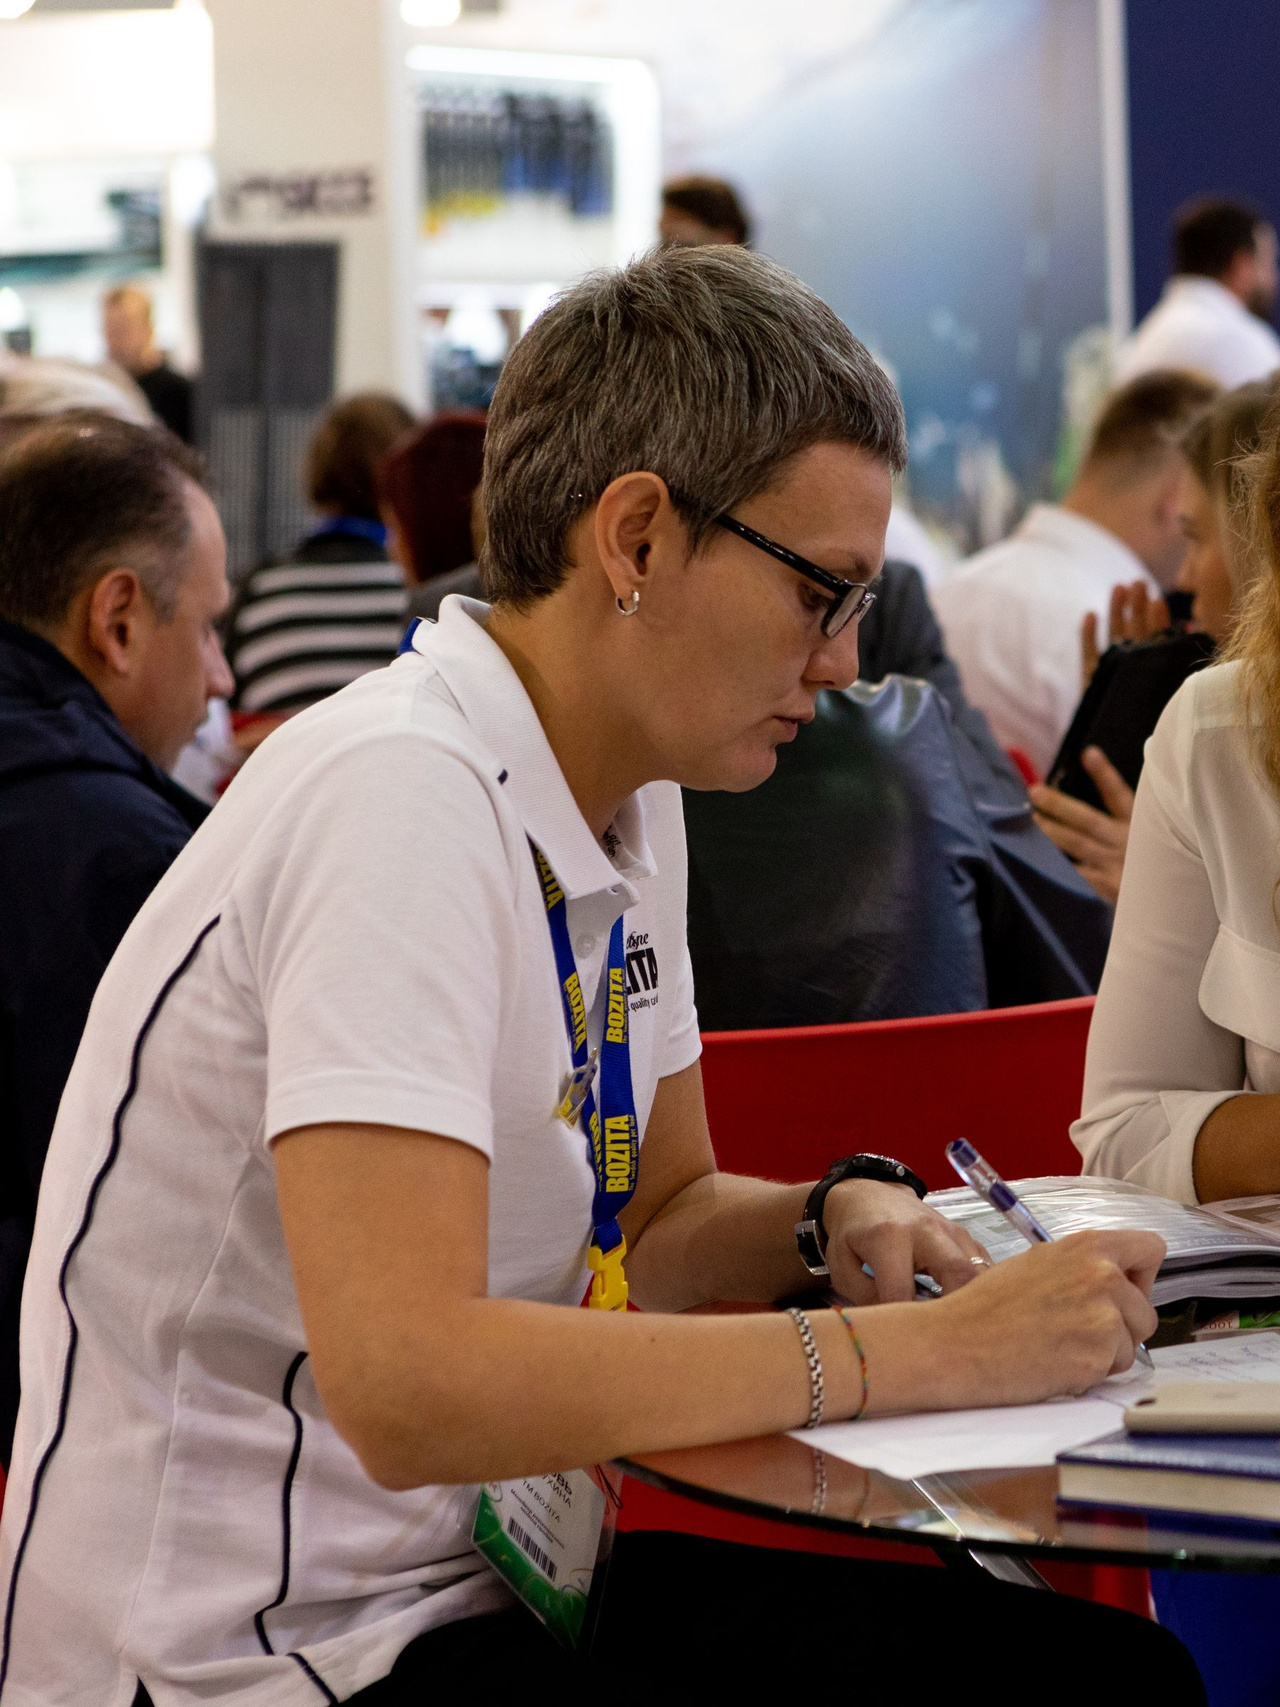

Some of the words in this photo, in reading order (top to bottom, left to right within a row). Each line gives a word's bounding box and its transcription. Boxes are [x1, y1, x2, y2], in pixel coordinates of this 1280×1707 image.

[564, 971, 588, 1054] BOZITA
[606, 967, 625, 1044] BOZITA
[604, 1114, 631, 1193] BOZITA
[533, 1491, 561, 1523] BOZITA
